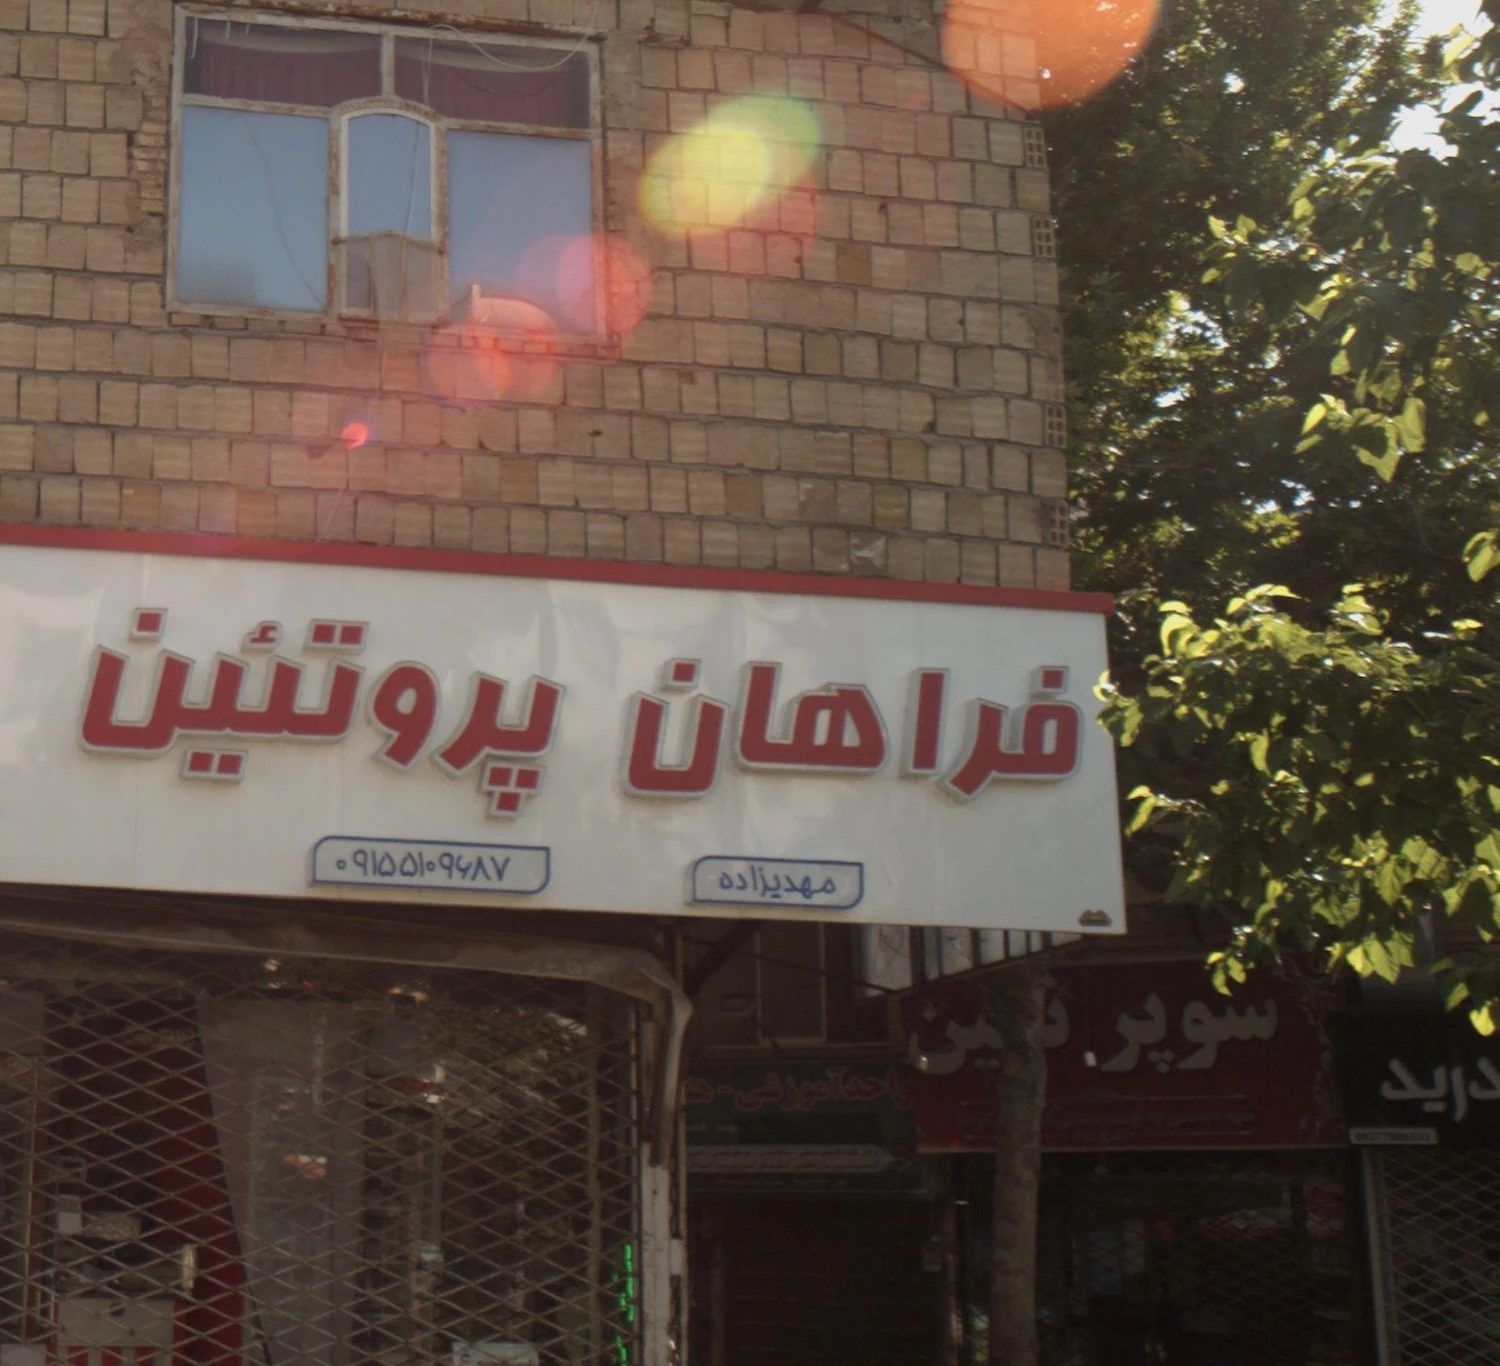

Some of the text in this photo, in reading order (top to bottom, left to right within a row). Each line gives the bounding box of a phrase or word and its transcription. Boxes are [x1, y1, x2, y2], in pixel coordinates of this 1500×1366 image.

[80, 607, 1082, 819] فراهان پروتئین
[333, 846, 512, 881] ۰۹۱۵۵۱۰۹۶۸۷
[718, 863, 837, 899] مهدیزاده
[1095, 991, 1278, 1076] سوپر
